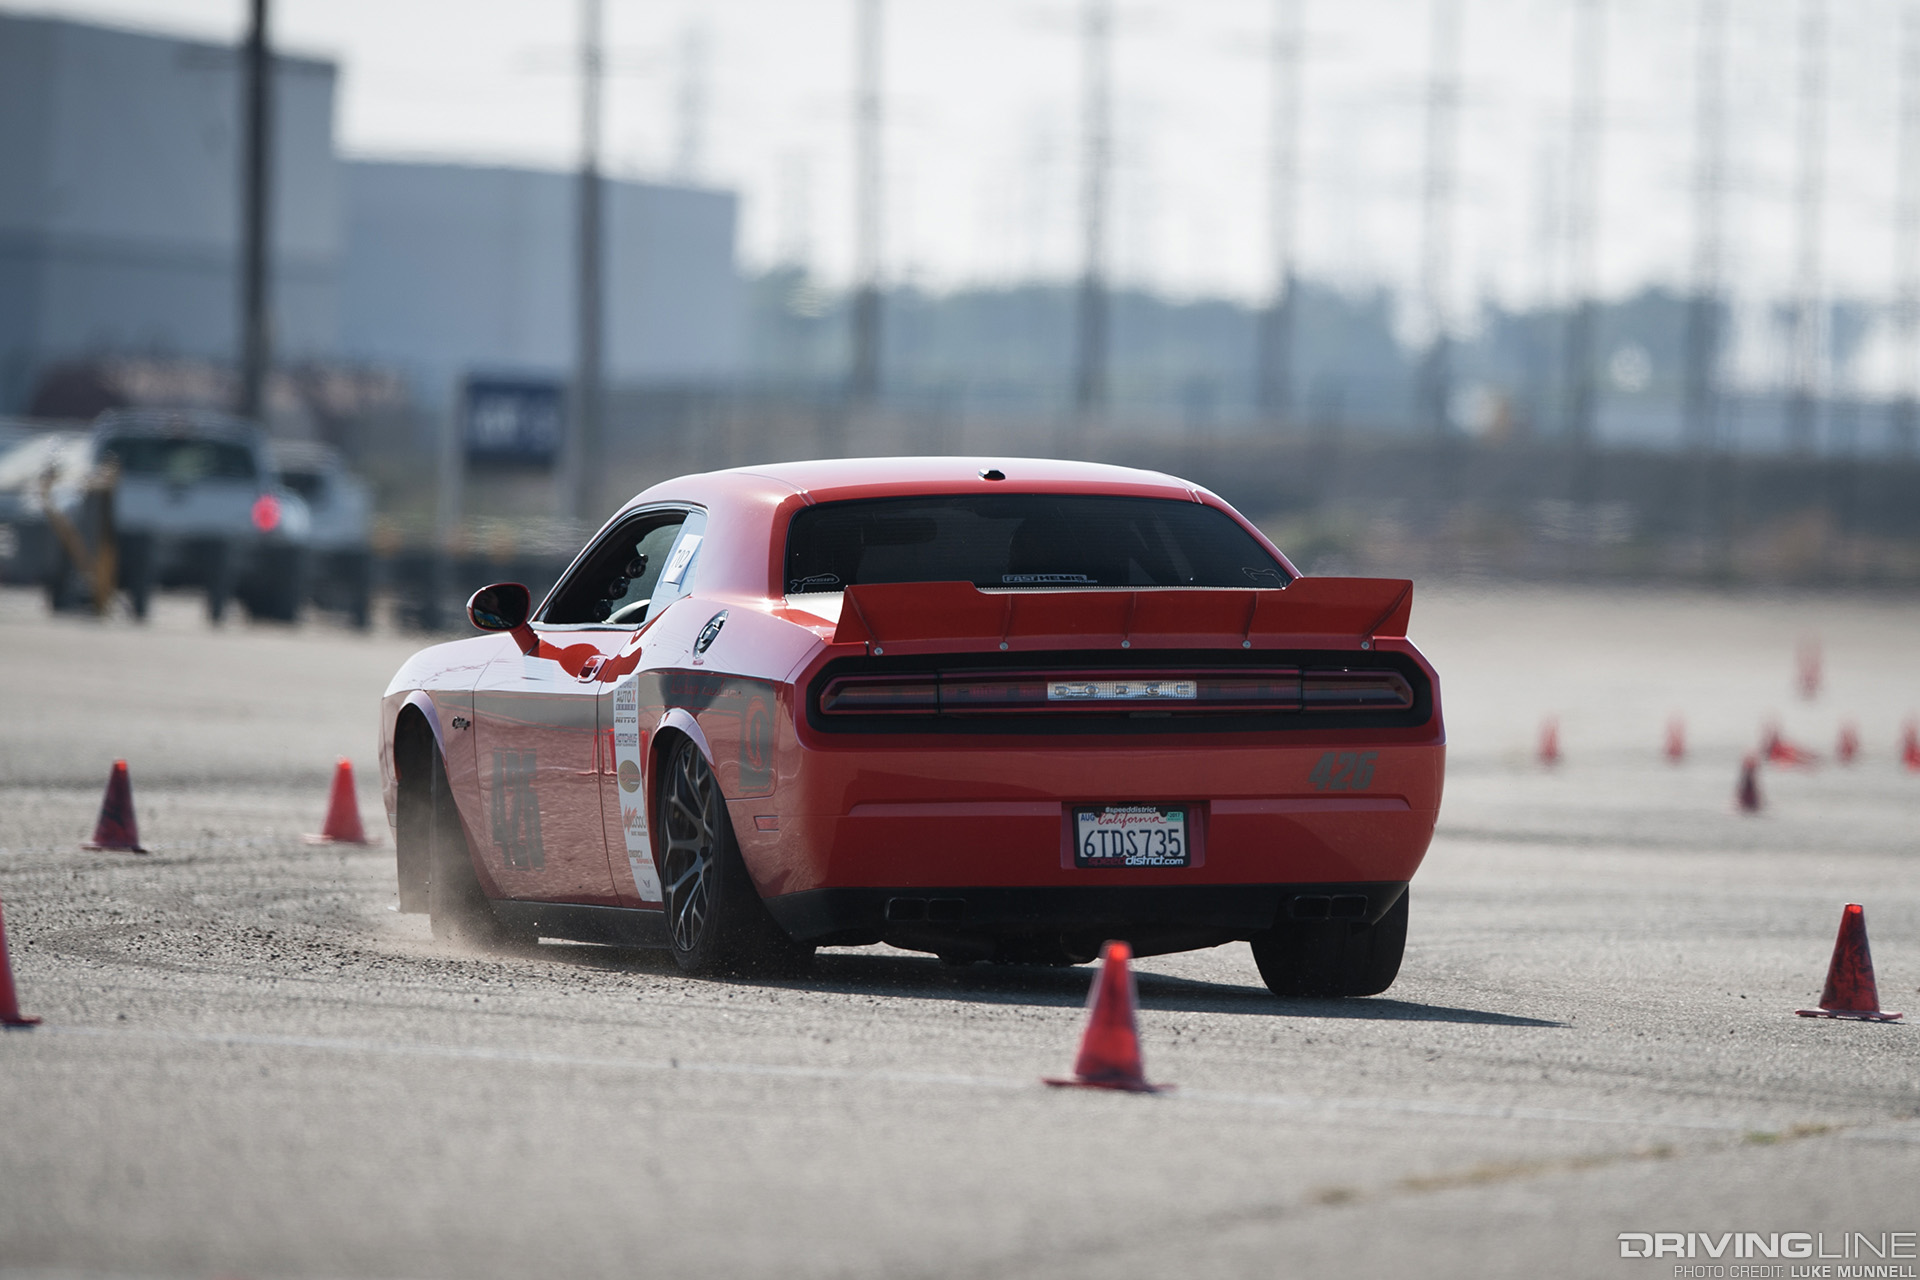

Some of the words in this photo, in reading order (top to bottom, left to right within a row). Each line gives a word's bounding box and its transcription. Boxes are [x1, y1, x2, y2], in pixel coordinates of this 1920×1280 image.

[1054, 684, 1190, 697] DODGE
[1307, 751, 1379, 790] 426
[1105, 806, 1157, 814] #speeddistrict
[1080, 813, 1095, 822] AUG
[1097, 812, 1166, 828] California
[1084, 829, 1182, 858] 6TDS735
